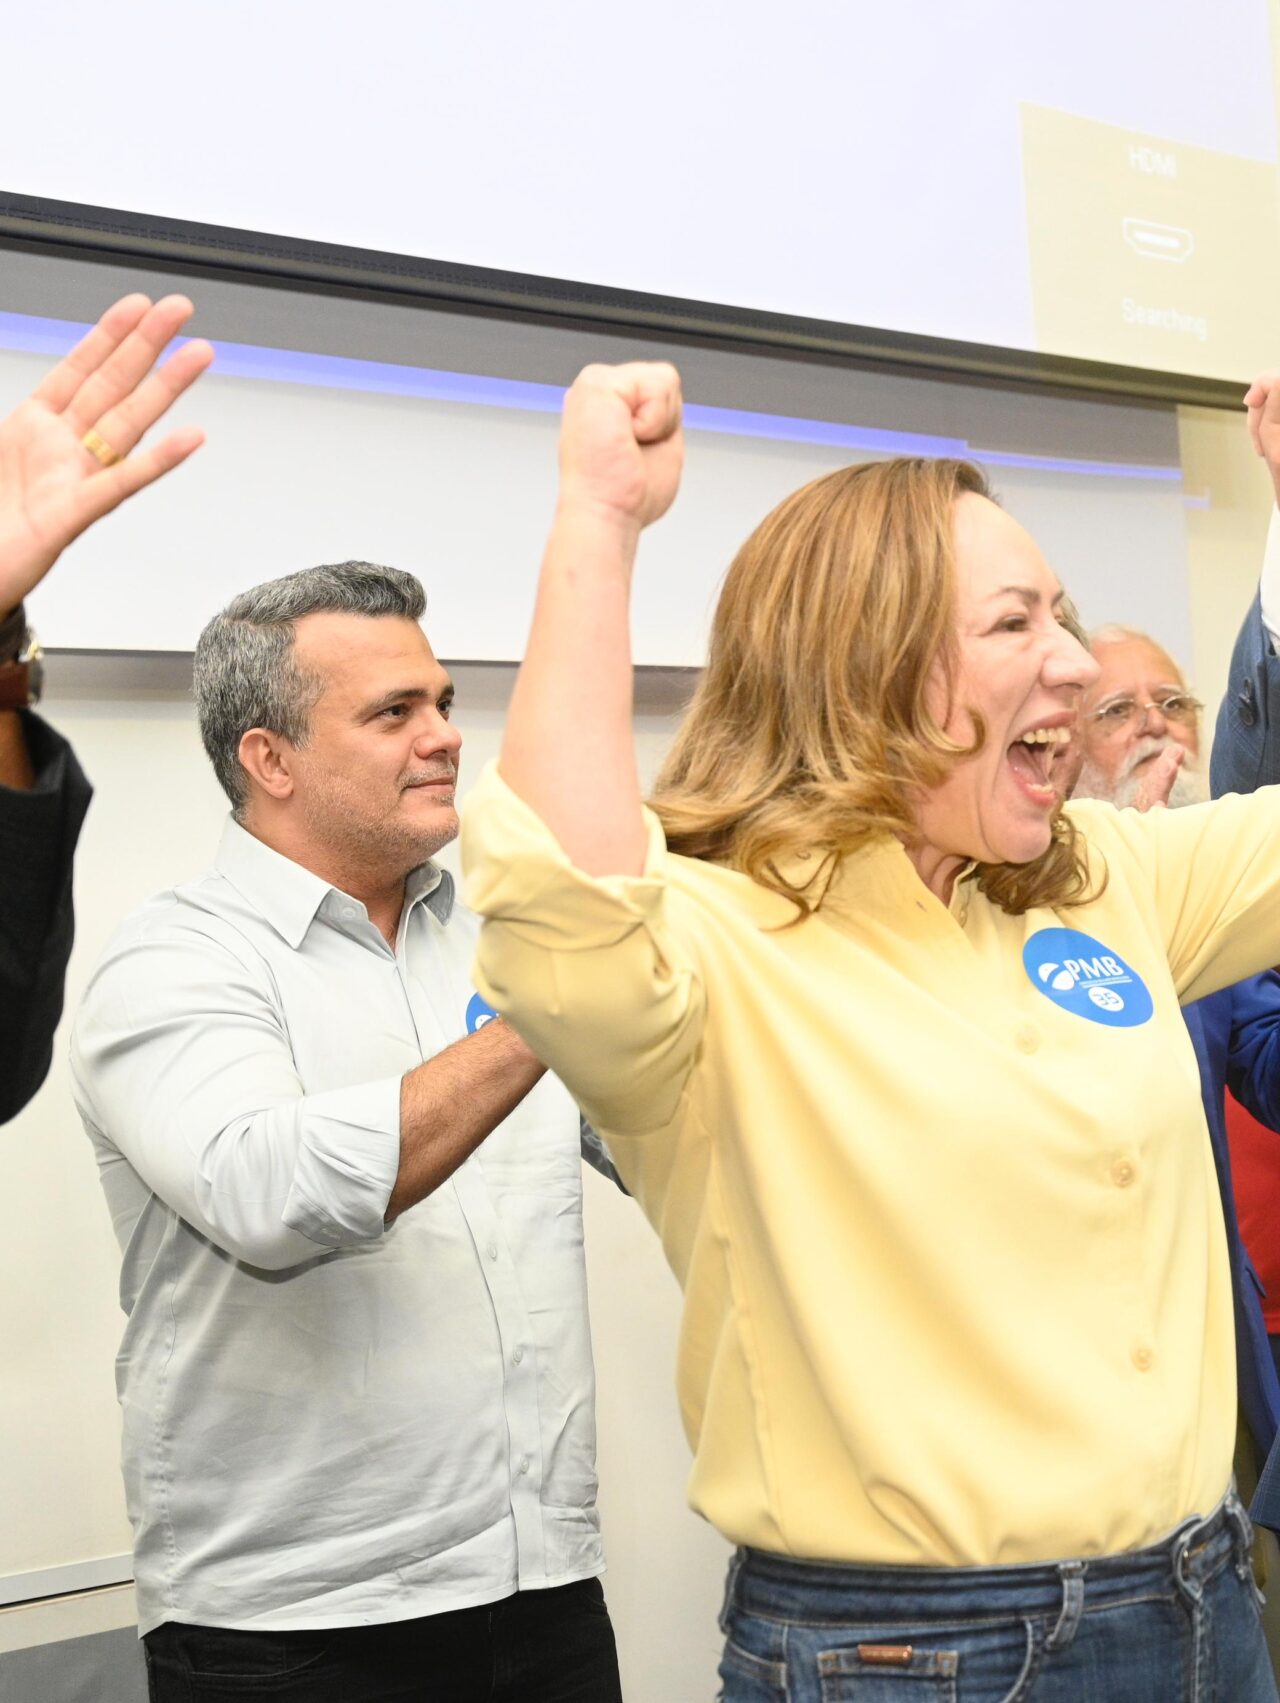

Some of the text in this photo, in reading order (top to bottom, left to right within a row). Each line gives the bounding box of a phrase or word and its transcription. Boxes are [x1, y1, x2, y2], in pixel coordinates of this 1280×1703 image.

[1130, 147, 1177, 178] HDMI
[1122, 298, 1207, 341] Searching
[1064, 956, 1124, 981] PMB
[1092, 992, 1121, 1006] 35
